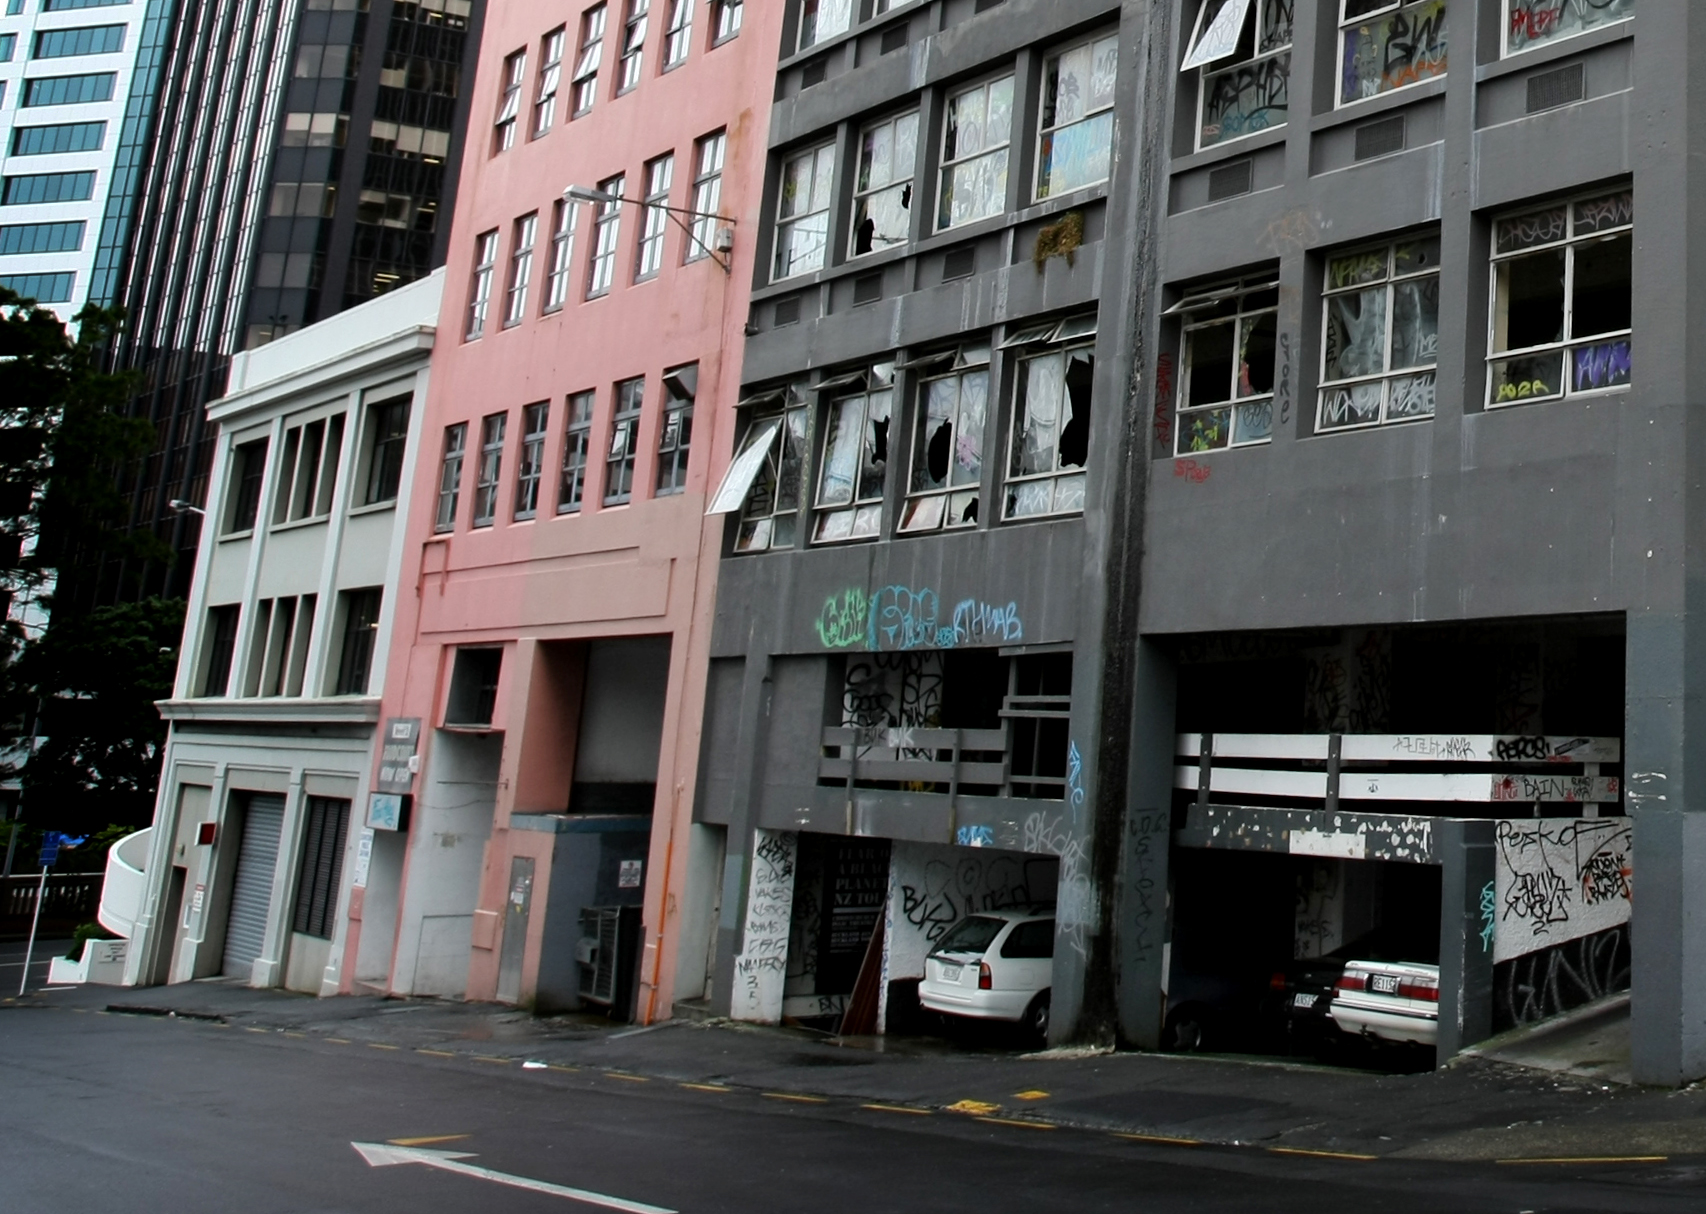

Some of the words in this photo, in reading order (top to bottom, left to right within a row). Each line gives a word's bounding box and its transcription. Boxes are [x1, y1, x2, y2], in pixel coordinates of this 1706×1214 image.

[838, 848, 875, 860] FEAR
[837, 863, 846, 875] A
[835, 877, 888, 891] PLANET
[834, 893, 853, 906] NZ
